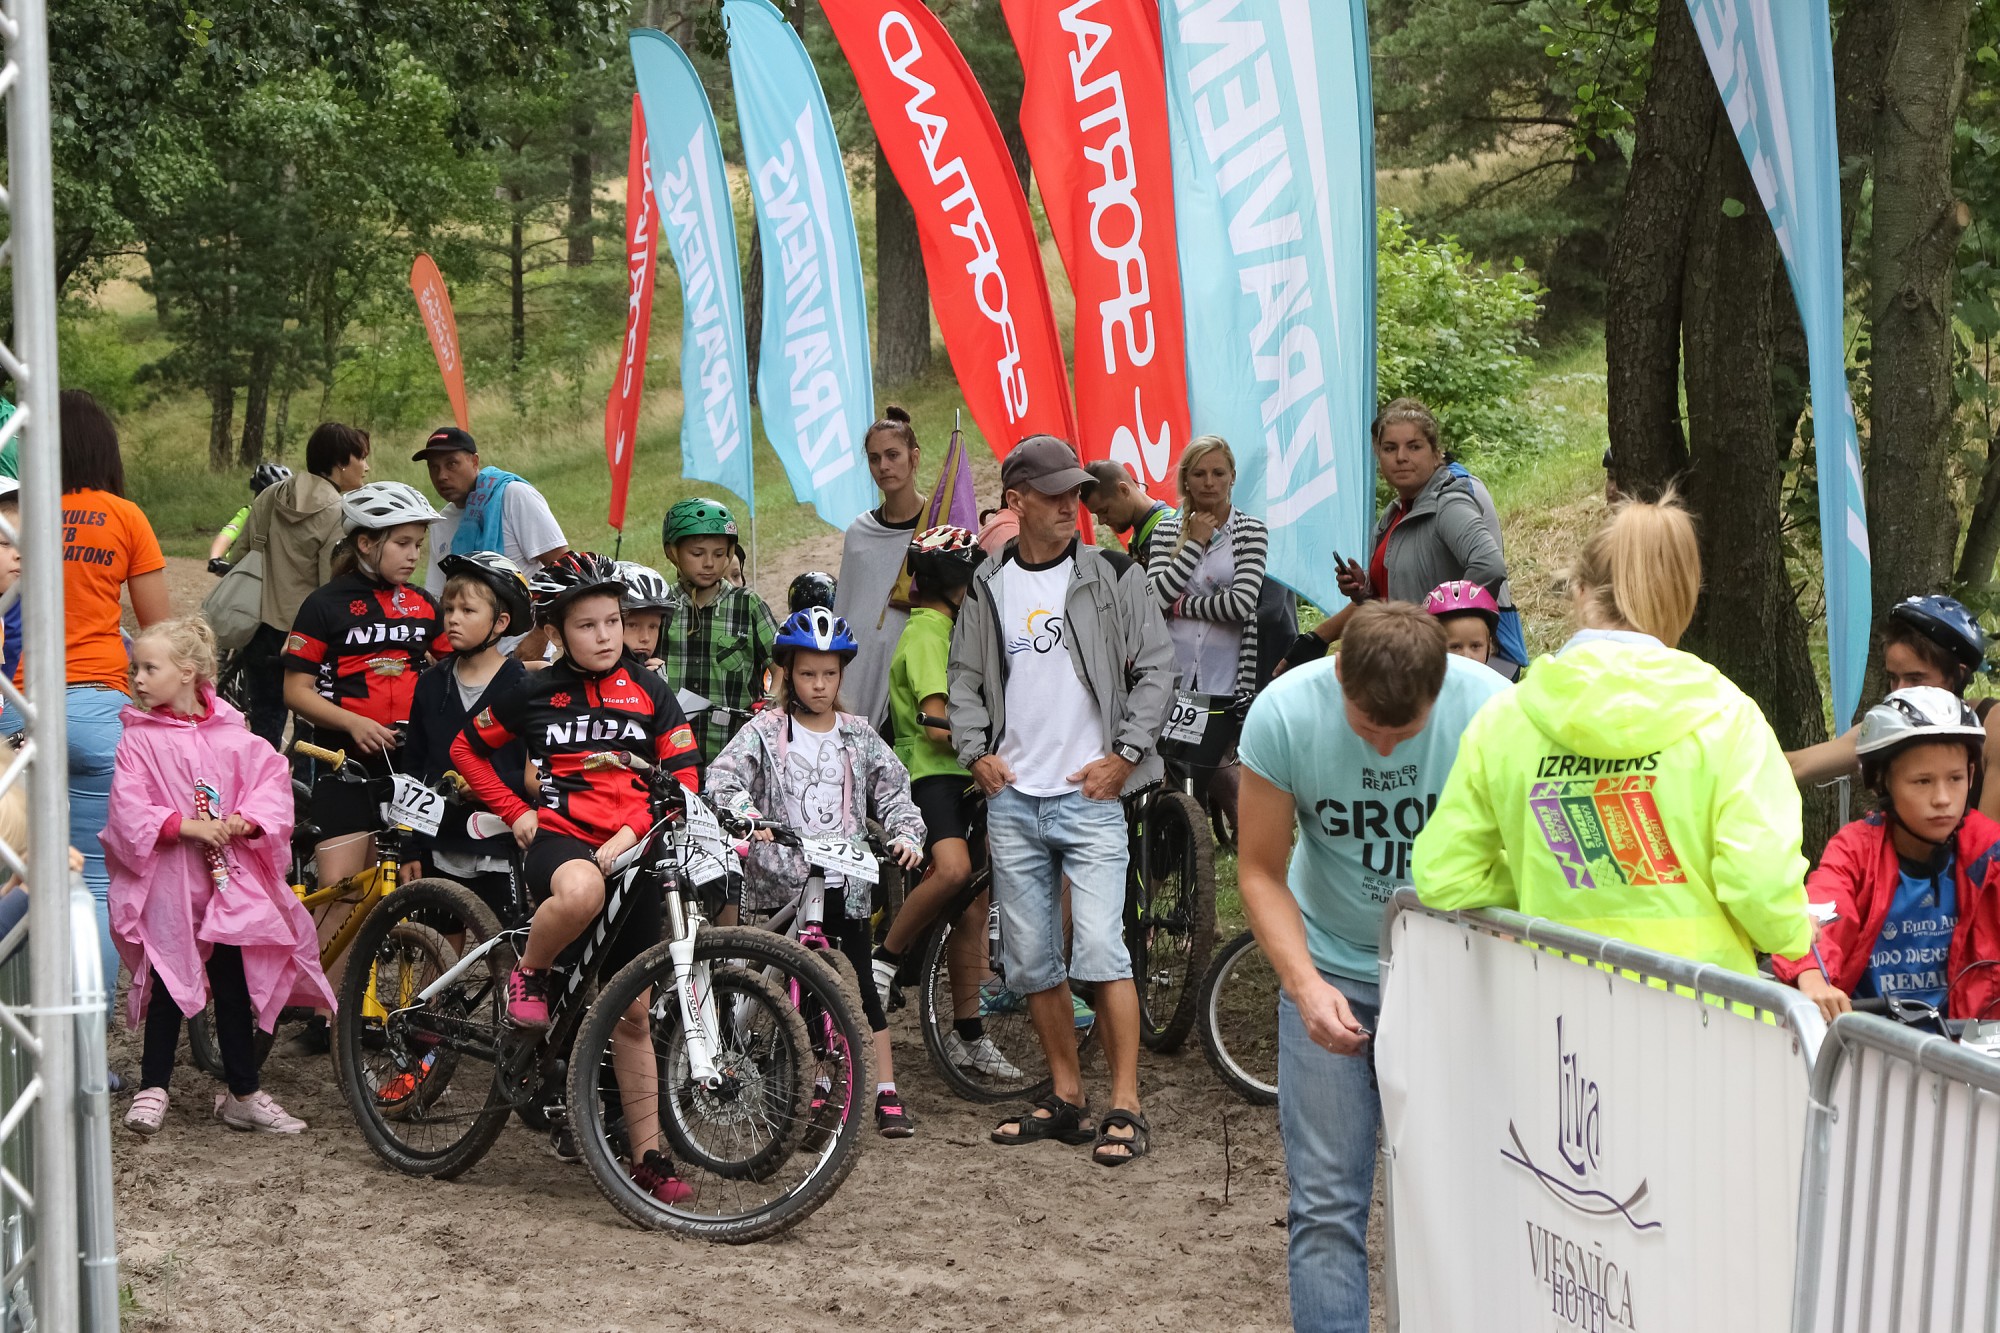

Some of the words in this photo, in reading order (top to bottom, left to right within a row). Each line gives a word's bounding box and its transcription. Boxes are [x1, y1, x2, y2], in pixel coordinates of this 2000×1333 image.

[62, 527, 77, 542] TB
[63, 546, 116, 567] ATONS
[1170, 704, 1197, 726] 09
[1363, 767, 1376, 778] WE
[1381, 765, 1417, 780] NEVER
[1362, 774, 1418, 792] REALLY
[399, 783, 436, 815] 372
[1902, 920, 1937, 934] Euro
[1880, 971, 1948, 992] RENAU
